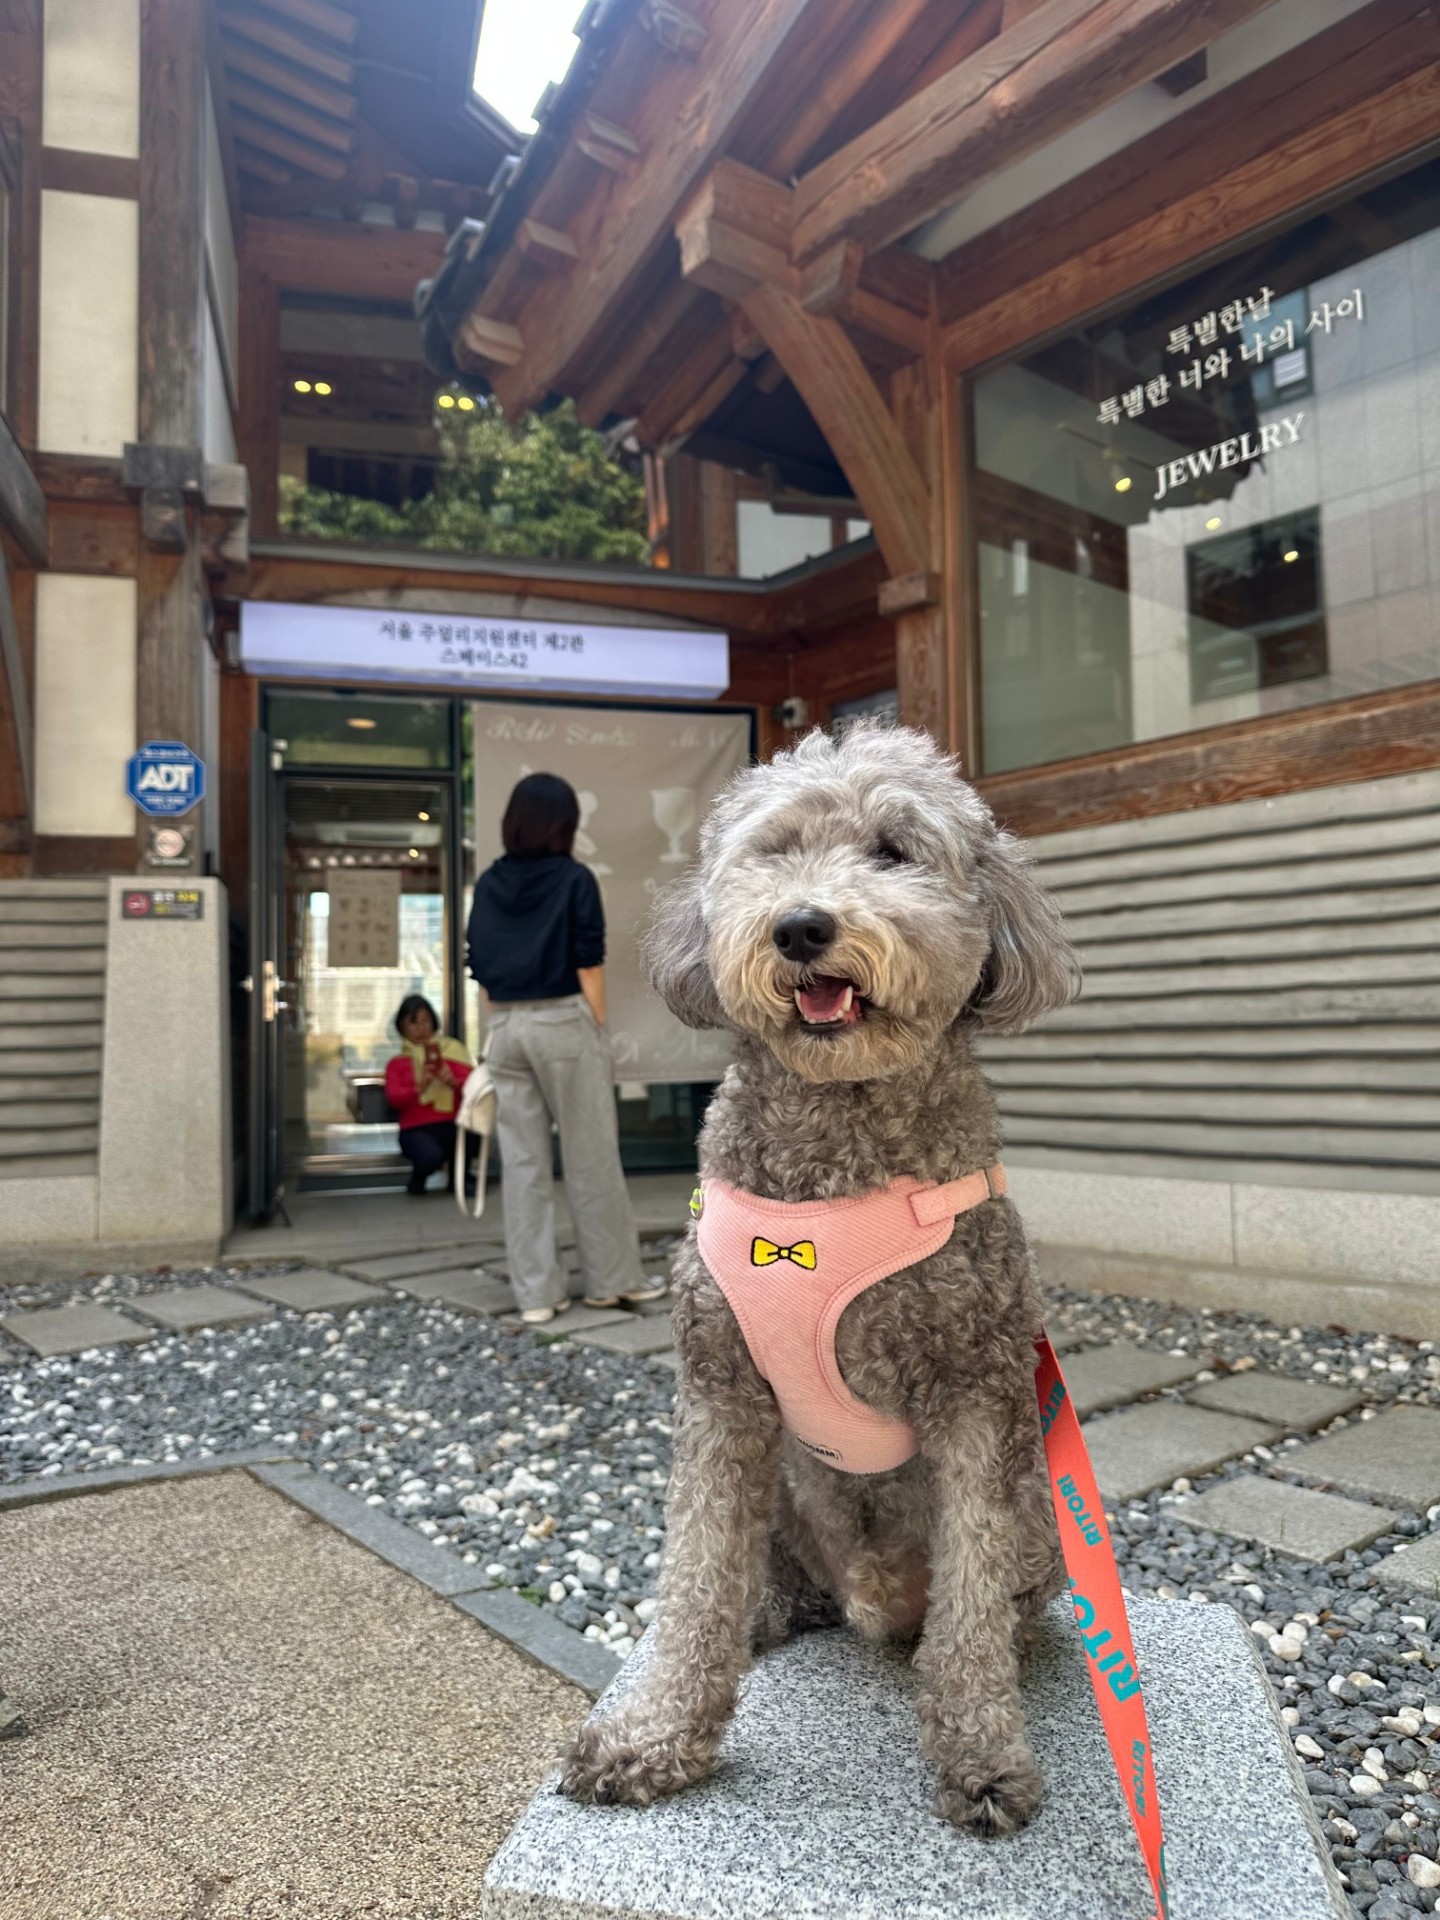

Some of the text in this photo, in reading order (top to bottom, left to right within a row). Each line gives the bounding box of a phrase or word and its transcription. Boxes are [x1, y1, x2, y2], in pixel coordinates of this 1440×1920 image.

[1166, 286, 1275, 354] 특별한날
[1097, 287, 1364, 424] 특별한 너와 나의 사이
[1154, 410, 1305, 500] JEWELRY
[380, 619, 413, 641] 서울
[419, 622, 538, 651] 주얼리지원센터
[440, 646, 528, 670] 스페이스42
[139, 763, 195, 792] ADT
[1042, 1379, 1067, 1437] RITO
[1056, 1473, 1103, 1547] RITORI
[1067, 1577, 1143, 1704] RITO
